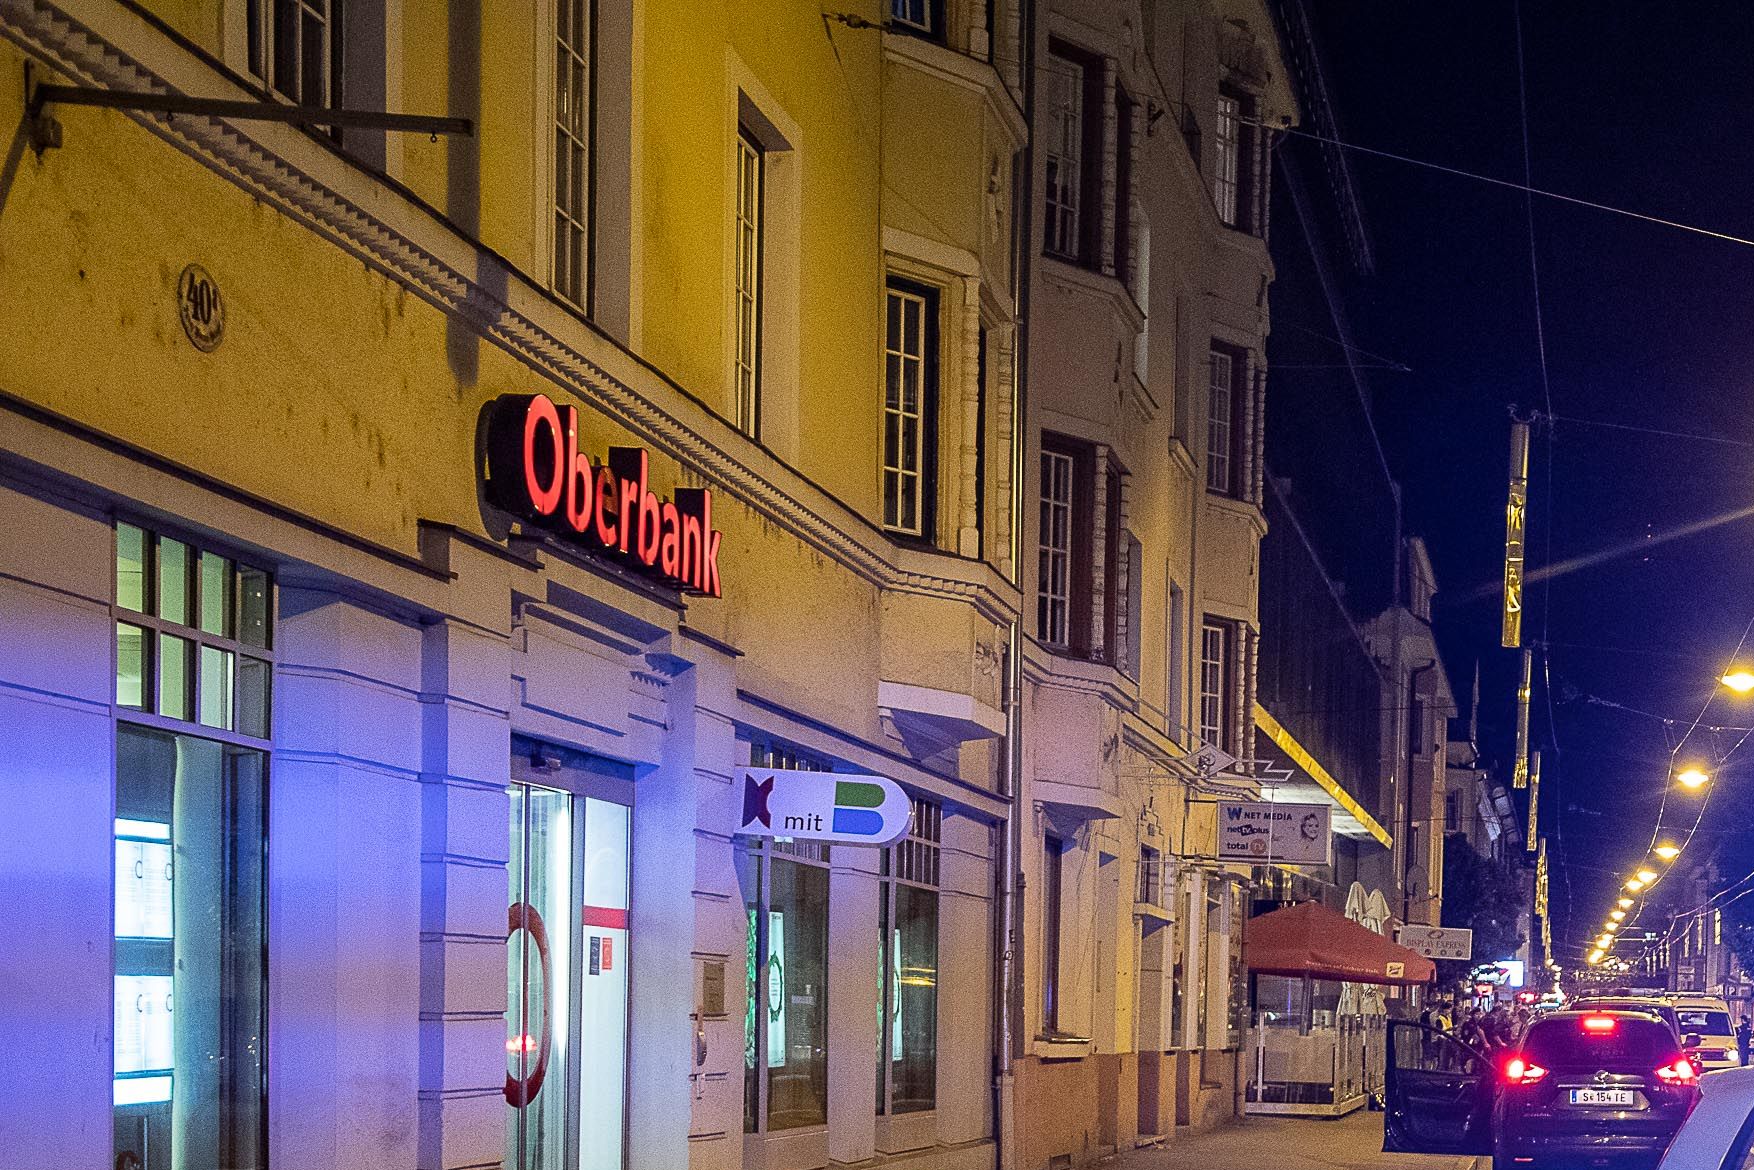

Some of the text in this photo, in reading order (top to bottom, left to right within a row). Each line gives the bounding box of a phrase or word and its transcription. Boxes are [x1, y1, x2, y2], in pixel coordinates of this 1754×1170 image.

[524, 394, 722, 598] Oberbank
[1244, 812, 1261, 820] NET
[784, 813, 823, 832] mit
[1227, 842, 1249, 850] total
[1406, 939, 1466, 949] DISPLAY EXPRESS
[1583, 1092, 1626, 1102] S 154 TE
